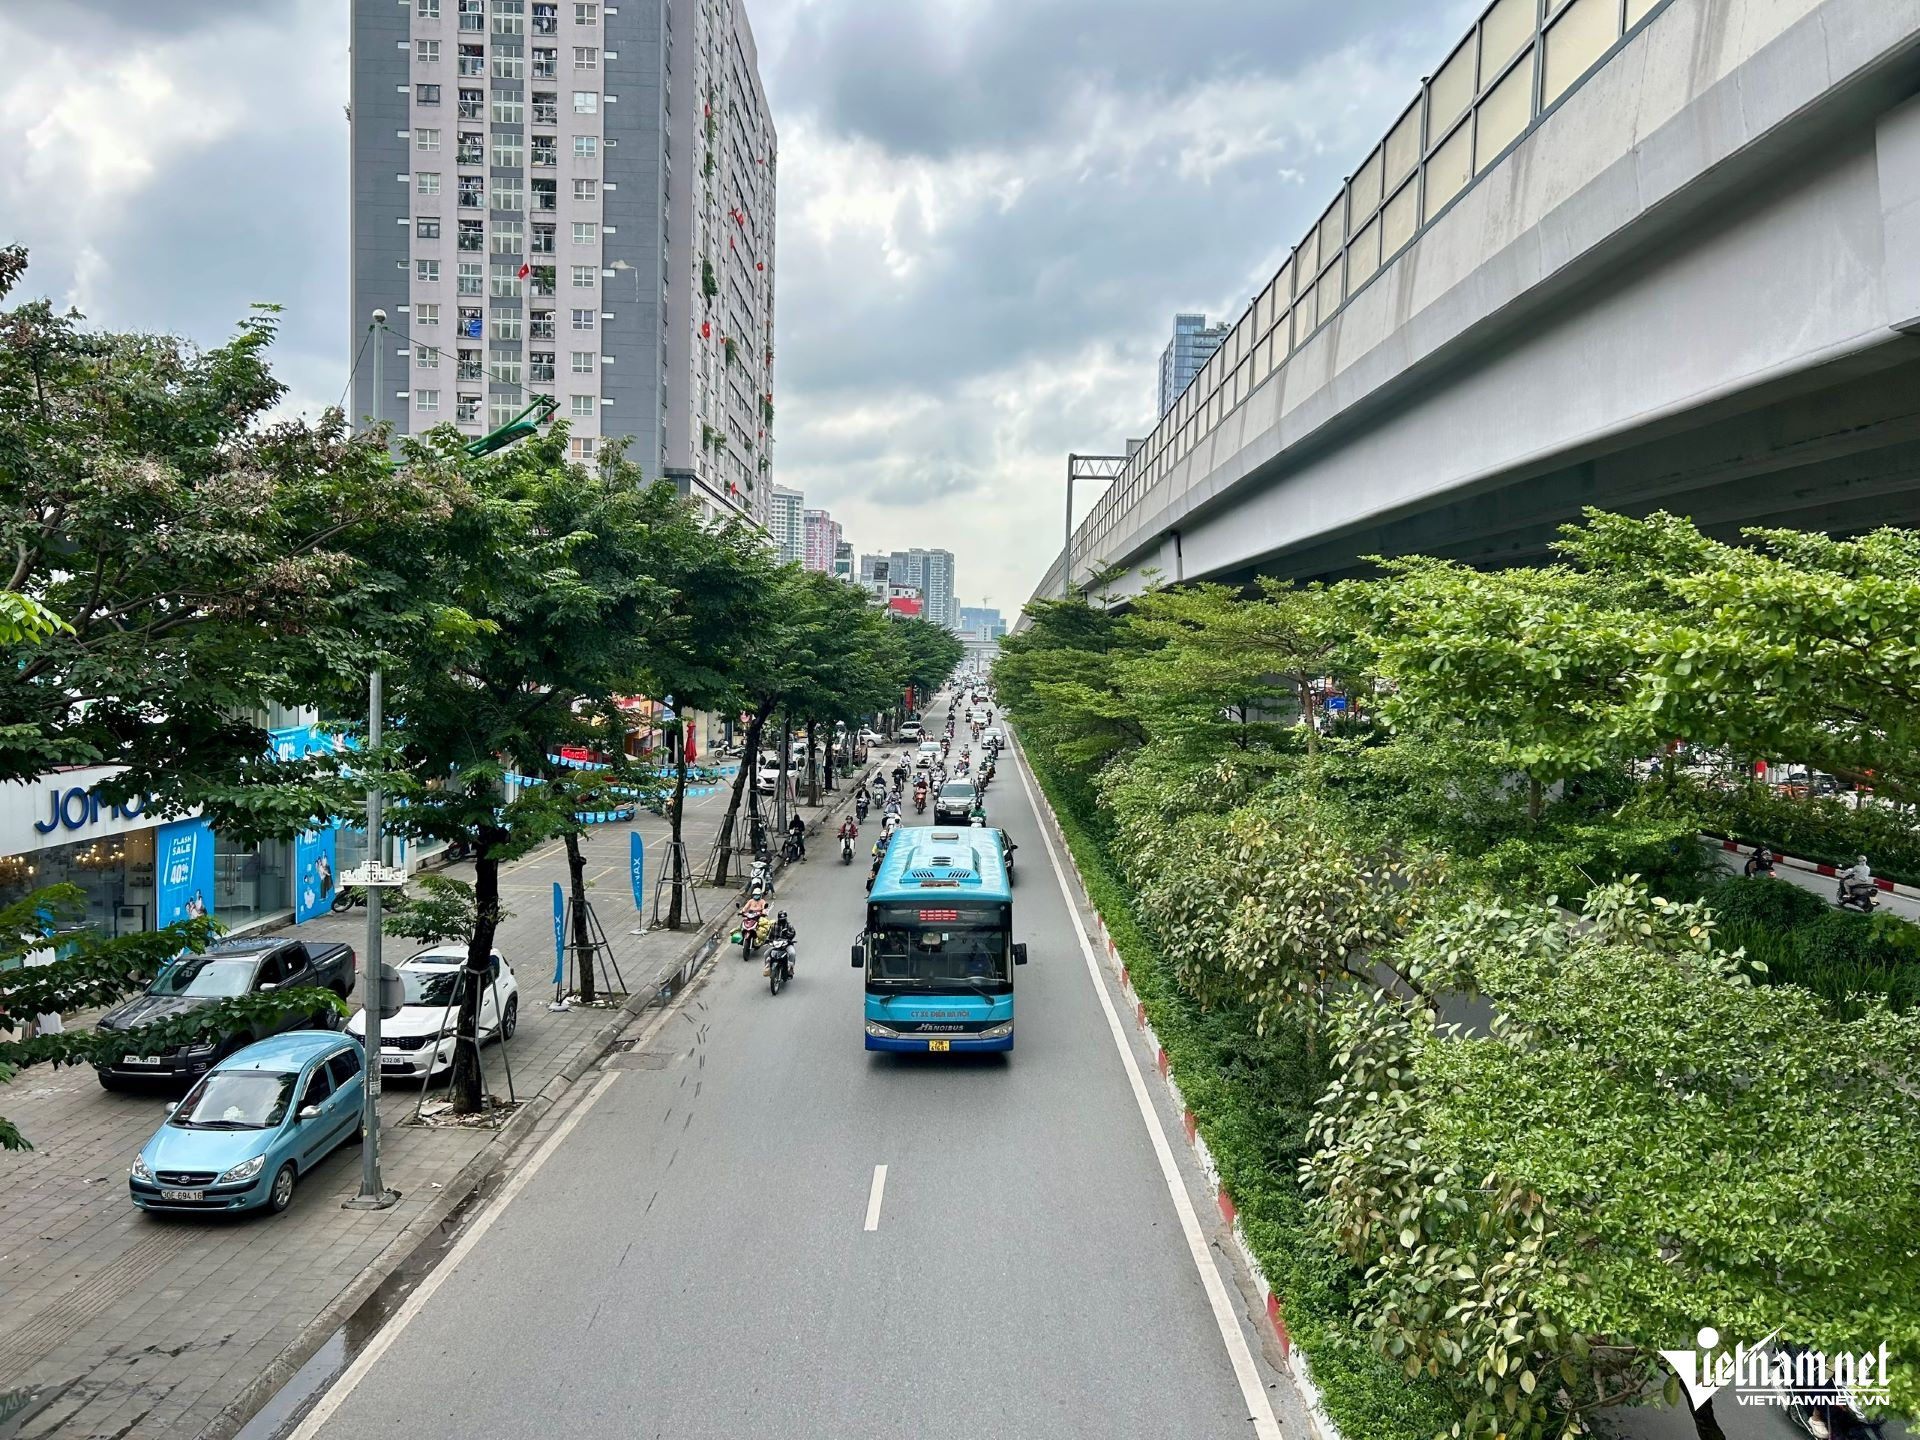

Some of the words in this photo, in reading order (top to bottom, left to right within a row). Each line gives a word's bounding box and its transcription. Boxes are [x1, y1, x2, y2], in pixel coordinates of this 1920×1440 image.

[34, 787, 152, 833] JOMO
[173, 835, 192, 846] FLASH
[172, 844, 191, 856] SALE
